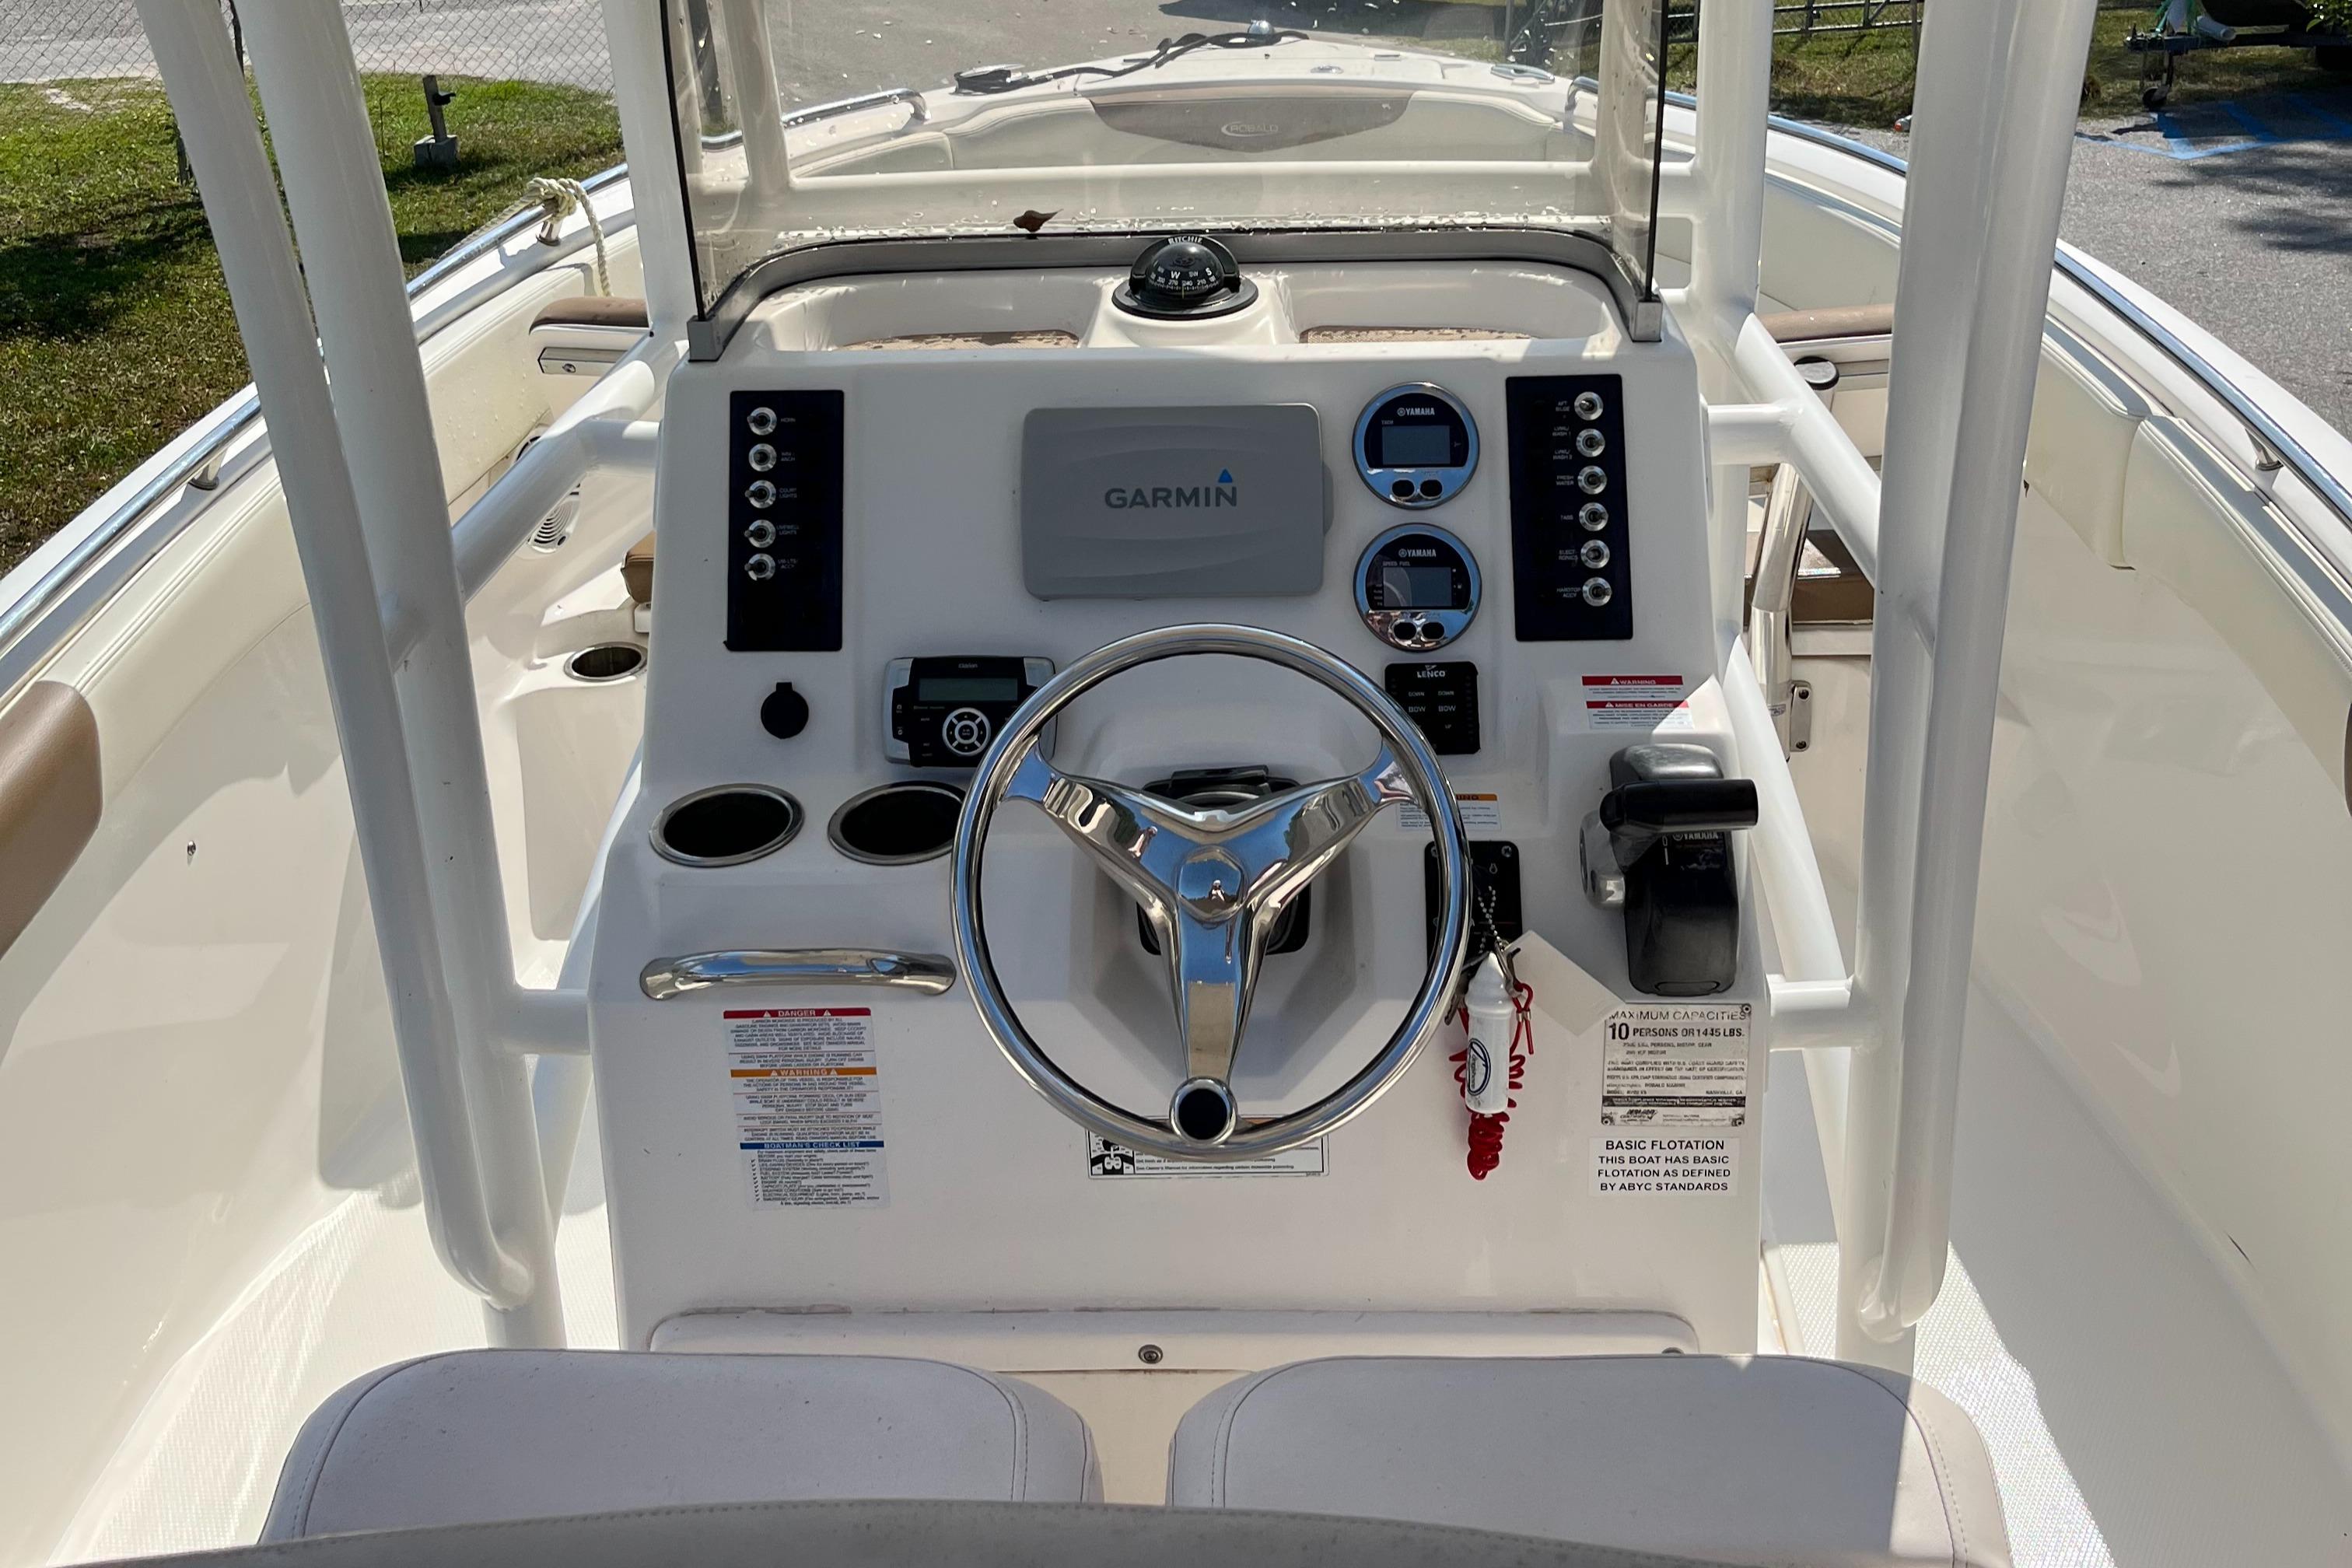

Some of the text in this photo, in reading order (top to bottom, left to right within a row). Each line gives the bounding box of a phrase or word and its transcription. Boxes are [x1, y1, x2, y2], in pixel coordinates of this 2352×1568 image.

[1168, 236, 1202, 245] RITCHIE
[1171, 271, 1181, 279] W
[1104, 486, 1237, 509] GARMIN
[1684, 831, 1718, 840] YAMAHA
[1609, 1011, 1746, 1020] MAXIMUM CAPACITIES
[1608, 1023, 1745, 1040] 10 PERSONS OR 1445 LBS.
[1605, 1140, 1724, 1150] BASIC FLOTATION
